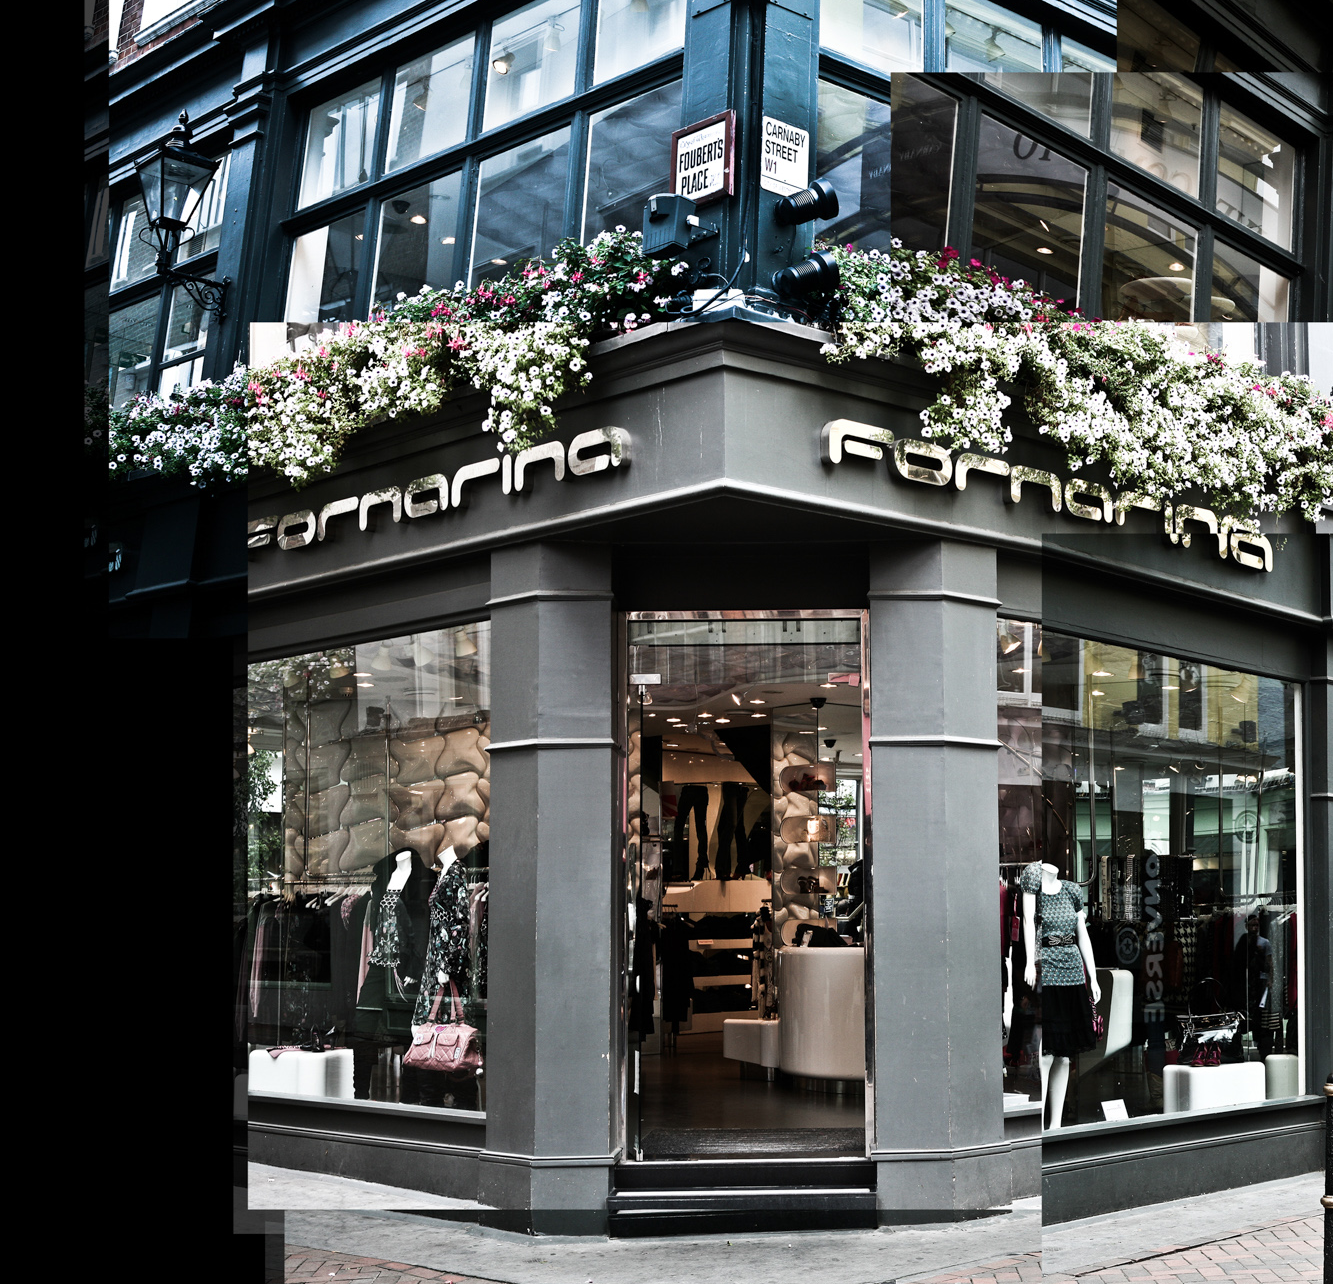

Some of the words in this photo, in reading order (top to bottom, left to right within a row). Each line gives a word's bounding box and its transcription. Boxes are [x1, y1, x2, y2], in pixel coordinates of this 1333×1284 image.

[765, 121, 806, 148] CARNABY
[679, 138, 723, 173] FOUBERT'S
[765, 139, 798, 163] STREET
[764, 157, 777, 174] W1
[681, 168, 709, 196] PLACE
